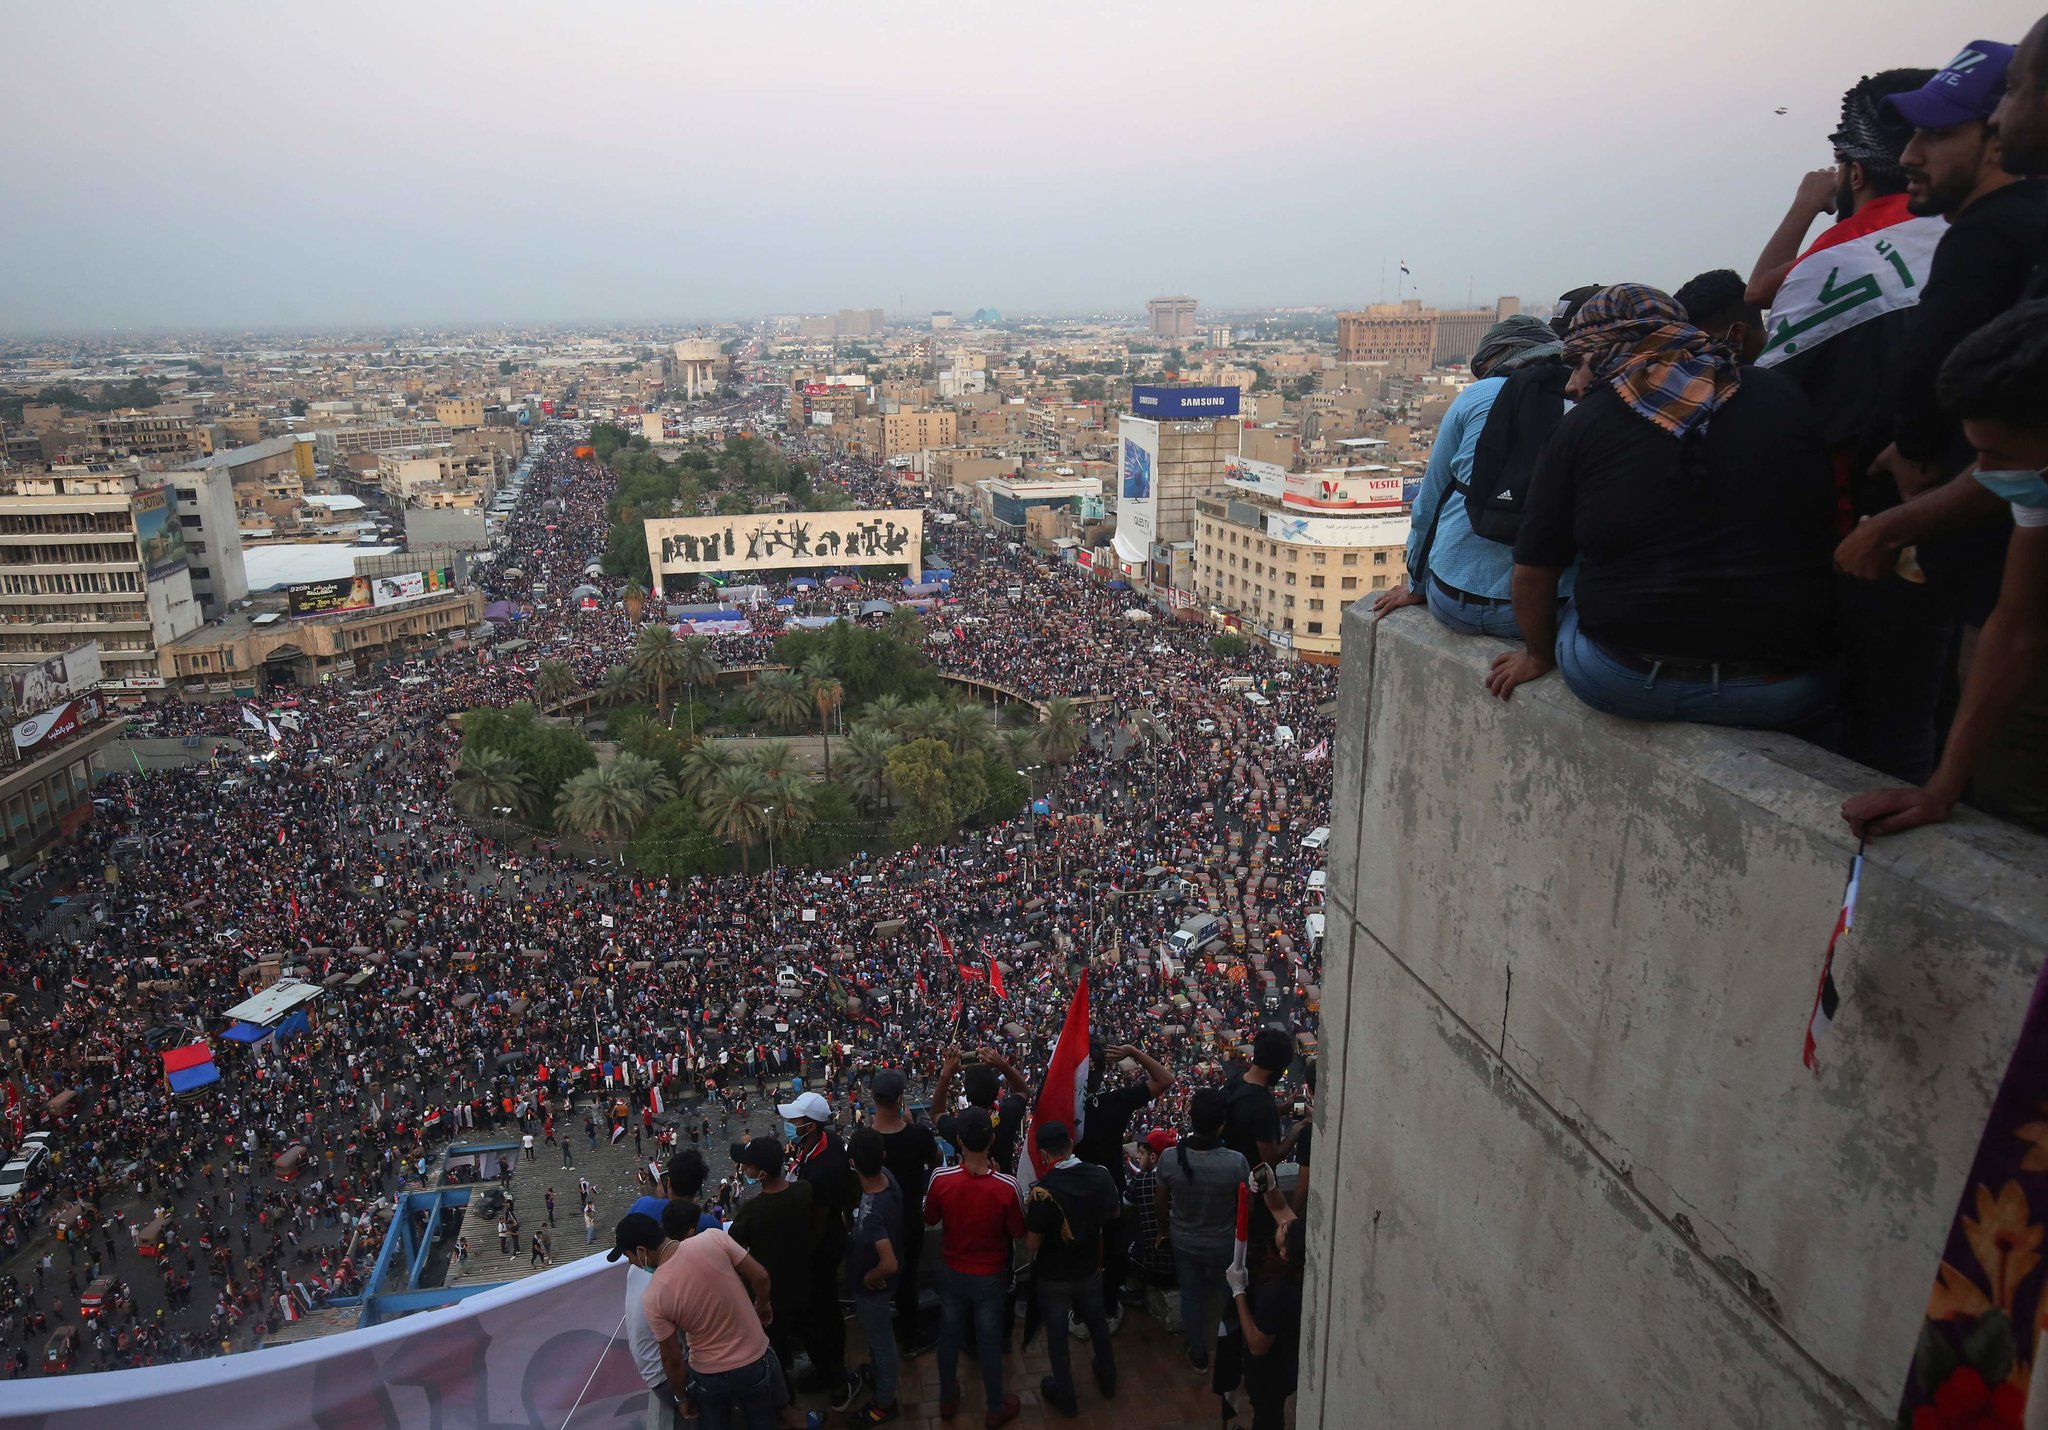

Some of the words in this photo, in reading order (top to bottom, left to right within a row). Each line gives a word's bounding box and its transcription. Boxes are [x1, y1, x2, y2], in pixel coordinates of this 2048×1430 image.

[1181, 397, 1225, 407] SAMSUNG
[1369, 480, 1401, 489] VESTEL
[143, 495, 165, 509] JOTUN
